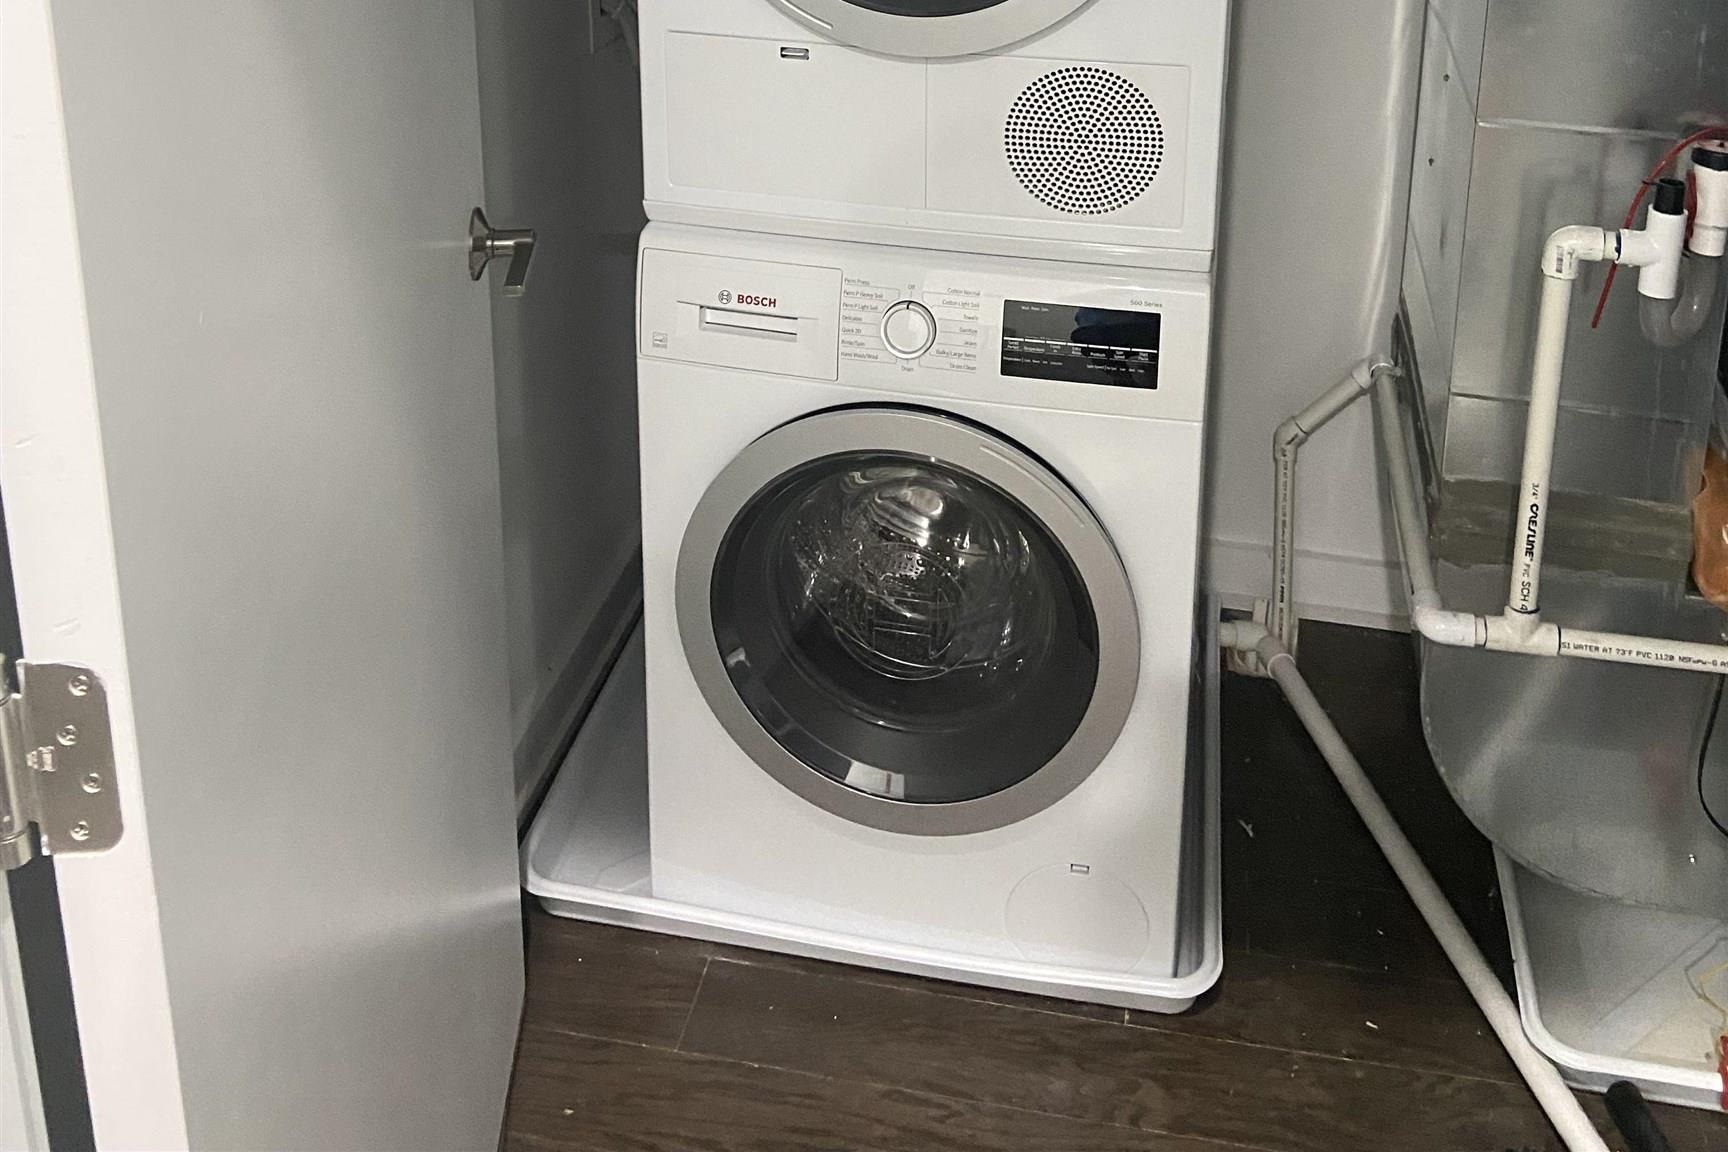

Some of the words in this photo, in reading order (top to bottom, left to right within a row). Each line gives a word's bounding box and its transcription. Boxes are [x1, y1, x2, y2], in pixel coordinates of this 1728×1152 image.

[736, 294, 777, 308] BOSCH
[1520, 580, 1531, 602] SCH
[1573, 643, 1599, 653] WATER
[1602, 646, 1613, 654] AT
[1636, 651, 1652, 659] PVC
[1655, 652, 1675, 662] 1120
